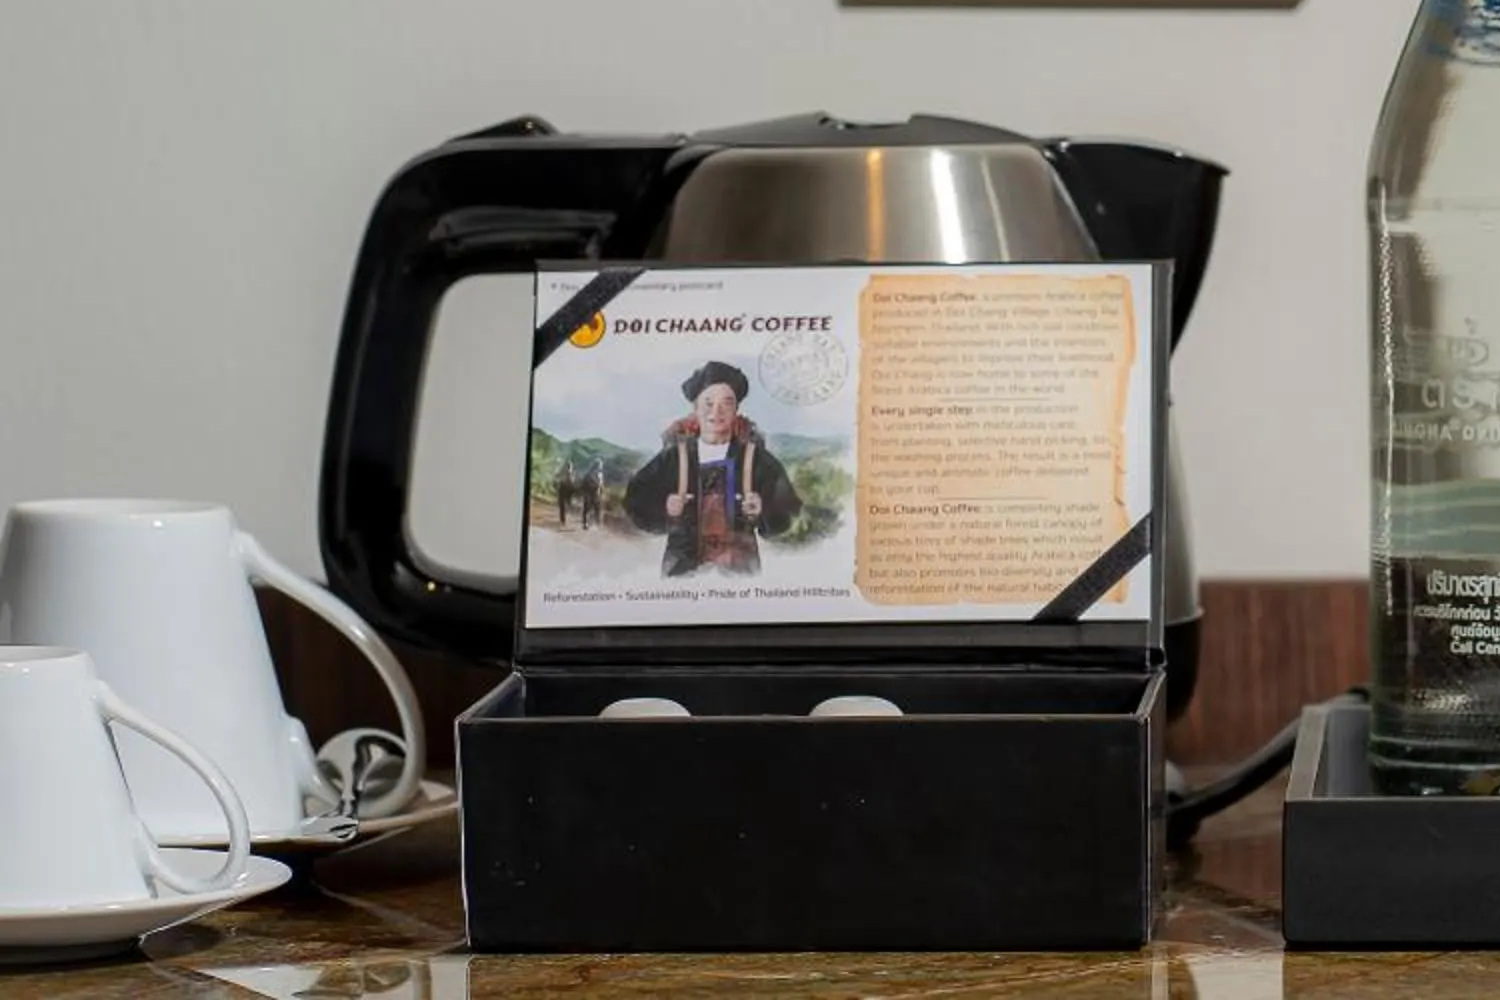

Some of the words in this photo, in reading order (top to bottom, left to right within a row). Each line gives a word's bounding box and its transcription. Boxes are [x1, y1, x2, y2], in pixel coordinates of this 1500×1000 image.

[613, 318, 649, 334] DOI
[656, 316, 743, 332] CHAANG
[751, 315, 833, 332] COFFEE
[871, 405, 905, 417] Every
[909, 405, 943, 417] single
[947, 405, 972, 417] step
[869, 504, 890, 516] Doi
[893, 504, 939, 516] Chaang
[942, 504, 980, 516] Coffee
[1005, 519, 1040, 531] forest
[869, 567, 889, 579] but
[892, 567, 916, 579] also
[543, 590, 616, 603] Reforestation
[625, 589, 699, 602] Sustainability
[708, 588, 737, 599] Pride
[740, 587, 751, 599] of
[754, 586, 800, 598] Thailand
[963, 583, 982, 595] the
[1450, 641, 1473, 655] Call
